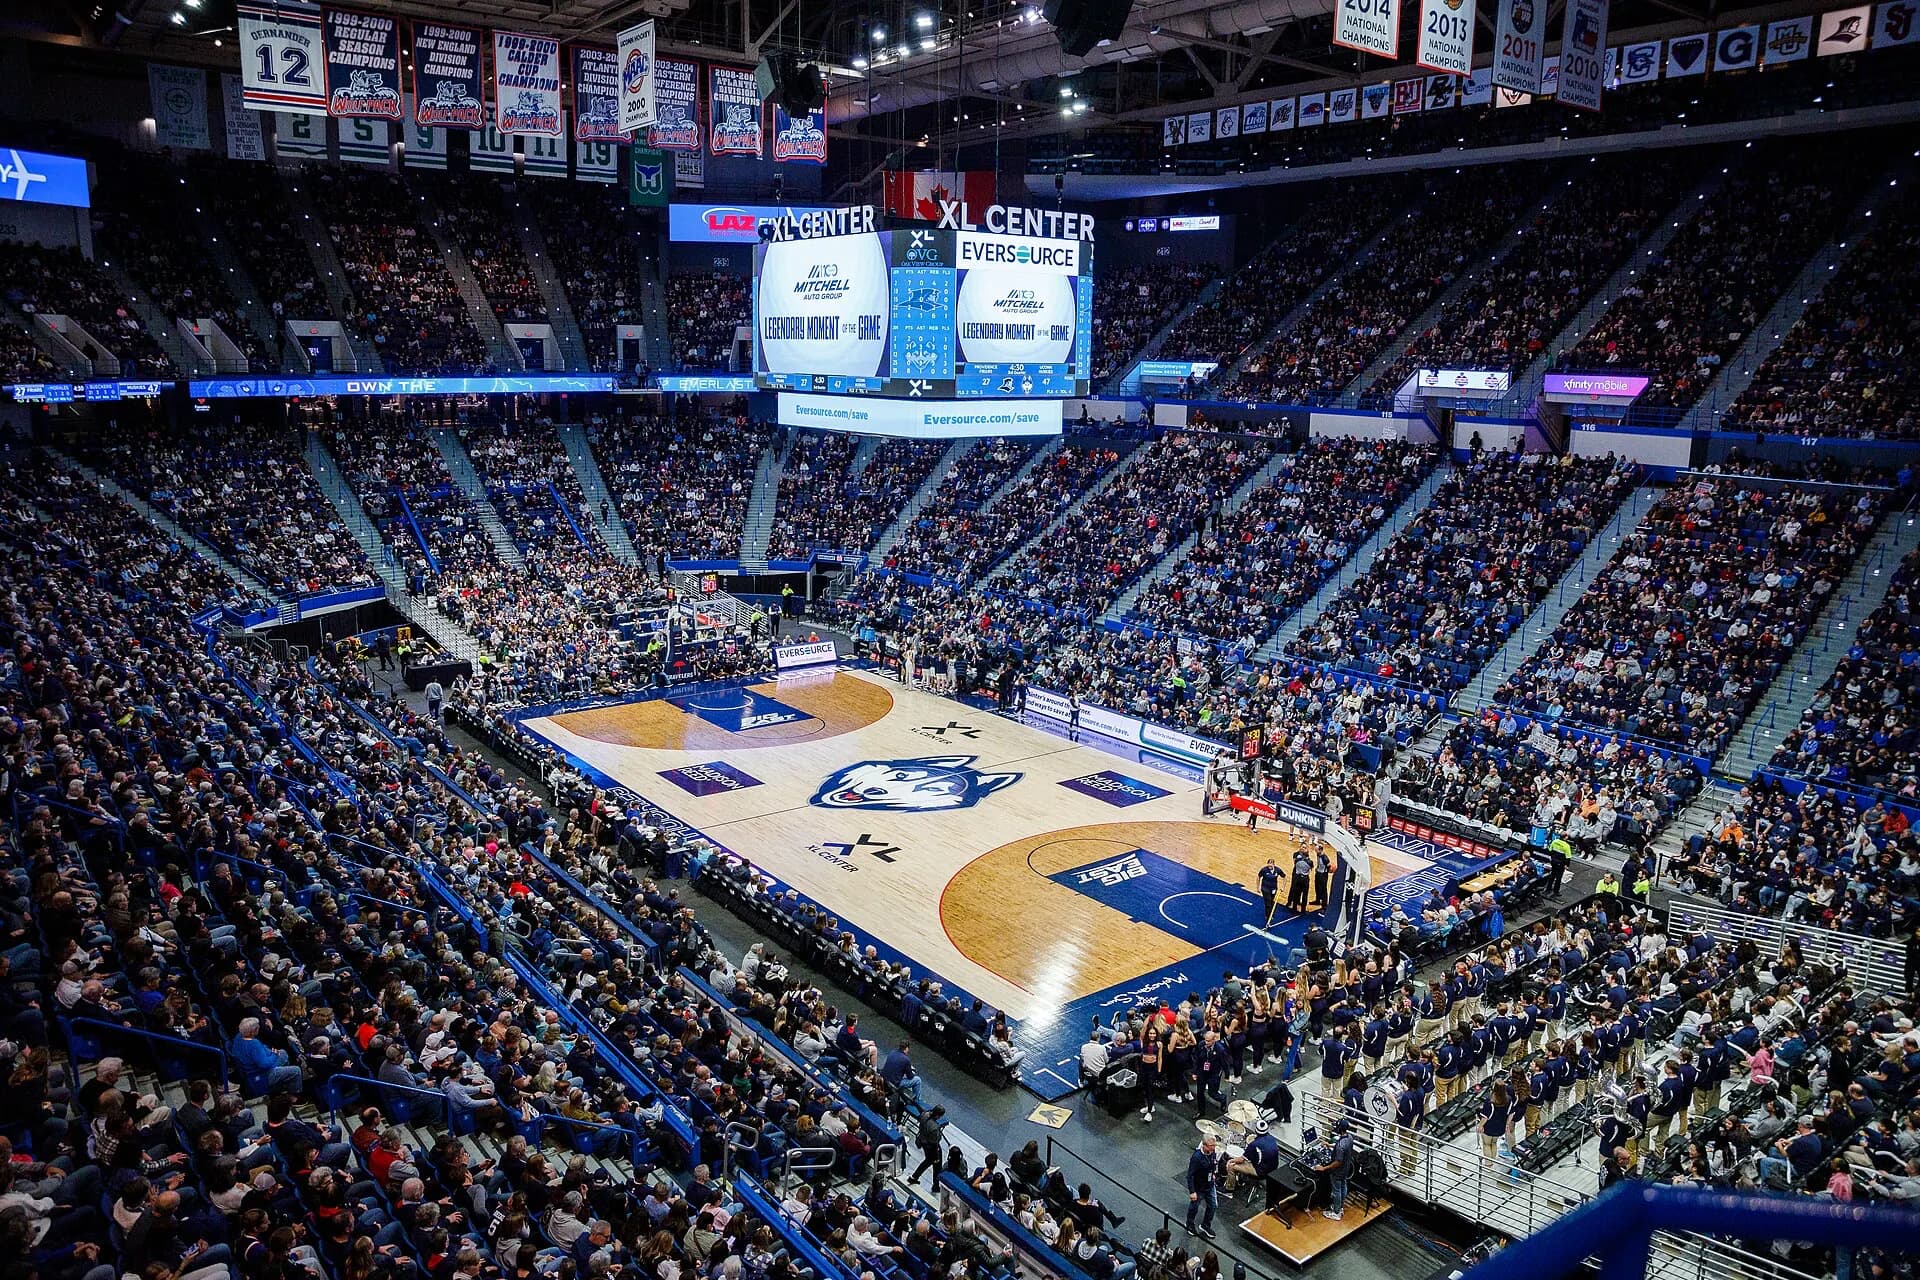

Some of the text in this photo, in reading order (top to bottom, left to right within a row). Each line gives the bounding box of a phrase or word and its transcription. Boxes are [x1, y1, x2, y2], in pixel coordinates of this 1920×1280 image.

[328, 12, 393, 31] 1999-2000
[1347, 16, 1387, 35] NATIONAL
[1428, 11, 1467, 41] 2013
[334, 26, 387, 43] REGULAR
[424, 26, 471, 41] 1999-2000
[1343, 30, 1389, 51] CHAMPIONS
[339, 40, 385, 56] SEASON
[416, 38, 476, 54] NEW ENGLAND
[1429, 39, 1465, 57] NATIONAL
[1502, 34, 1536, 63] 2011
[1719, 32, 1752, 65] G
[329, 52, 395, 70] CHAMPIONS
[429, 52, 467, 66] DIVISION
[508, 50, 548, 66] CALDER
[580, 49, 619, 62] 2003-20
[1425, 52, 1466, 71] CHAMPIONS
[256, 44, 310, 86] 12
[424, 64, 473, 79] CHAMPIONS
[518, 64, 539, 76] CUP
[582, 61, 619, 74] ATLANTI
[654, 60, 694, 73] 003-2004
[1501, 61, 1534, 77] NATIONAL
[1564, 53, 1599, 80] 2010
[717, 78, 757, 90] ATLANTIC
[1497, 73, 1536, 91] CHAMPIONS
[1566, 79, 1595, 94] NATIONAL
[578, 84, 619, 97] CHAMPION
[655, 89, 695, 101] AMPIONS
[719, 85, 756, 97] DIVISION
[627, 98, 646, 112] 2000
[714, 93, 760, 106] CHAMPIONS
[1562, 91, 1597, 107] CHAMPIONS
[626, 111, 649, 123] CHAMPIONS
[292, 113, 311, 139] 2
[353, 118, 373, 141] 5
[417, 126, 433, 150] 9
[478, 126, 506, 152] 10
[582, 142, 611, 166] 19
[709, 215, 755, 230] LAZ
[773, 205, 875, 242] XL CENTER
[937, 200, 1095, 242] XL CENTER
[910, 230, 935, 248] XL
[962, 241, 1074, 267] EVERSOURCE
[794, 279, 850, 293] MITCHELL
[821, 292, 842, 300] GROUP
[993, 300, 1045, 309] MITCHELL
[764, 315, 881, 340] LEGENDARY MOMENT OF THE GAME
[963, 322, 1004, 339] LEGENDARY
[1005, 324, 1035, 341] MOMENT
[1050, 325, 1070, 341] GAME
[15, 387, 25, 396] 27
[148, 384, 159, 393] 47
[347, 381, 435, 394] OWN THE
[909, 379, 933, 397] XL
[1564, 379, 1628, 392] xfinity mobile
[795, 404, 869, 420] Eversource.com/save
[924, 413, 1039, 426] Eversource.com/save
[1800, 437, 1817, 446] 117
[1029, 692, 1064, 708] inter's around
[1034, 701, 1047, 711] ways
[1053, 708, 1064, 717] save
[922, 721, 983, 739] XL
[1243, 740, 1258, 759] 30
[678, 768, 711, 782] REED
[694, 764, 745, 790] MADISON
[1075, 778, 1118, 794] REED
[1086, 775, 1158, 801] MADISON
[823, 834, 903, 863] XL
[805, 844, 859, 873] XL CENTER
[1078, 857, 1142, 884] EAST
[1101, 865, 1148, 887] BIG
[1128, 972, 1189, 995] Mohegan
[1100, 993, 1133, 1007] Sun
